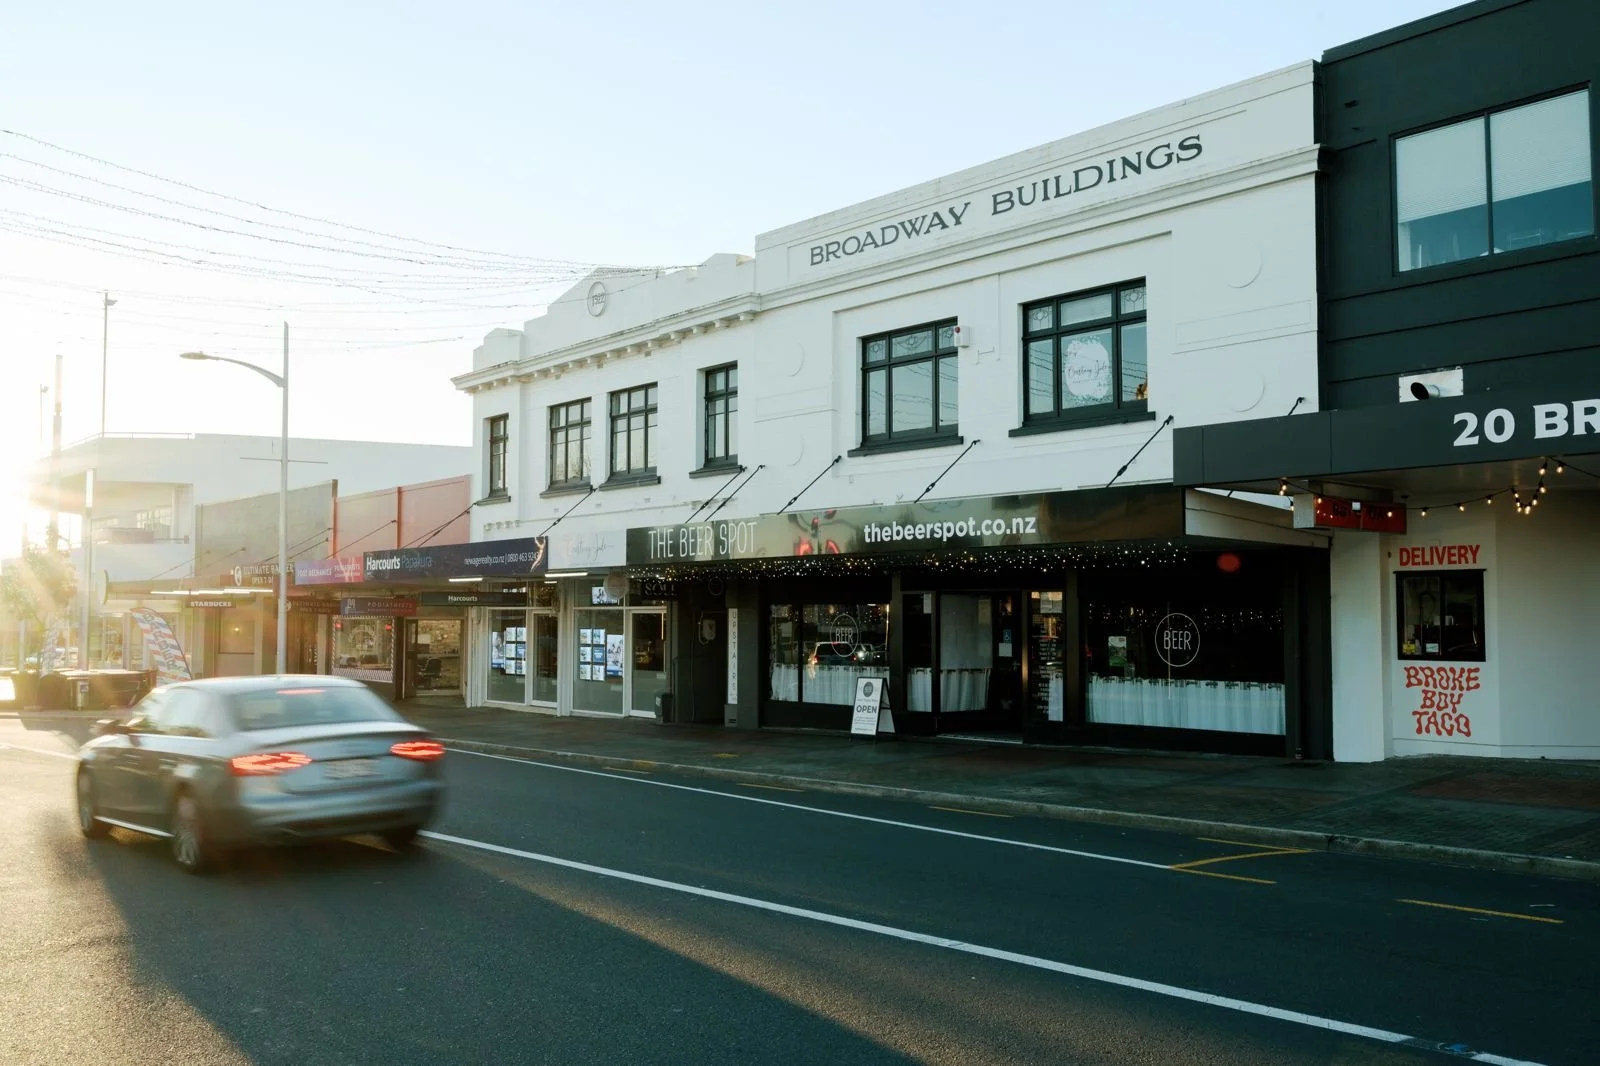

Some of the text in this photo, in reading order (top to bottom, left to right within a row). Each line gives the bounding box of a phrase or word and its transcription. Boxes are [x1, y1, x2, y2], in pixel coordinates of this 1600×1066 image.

[810, 134, 1203, 266] BROADWAY BUILDINGS
[1453, 399, 1600, 447] 20 BR
[648, 527, 674, 559] THE
[679, 525, 714, 558] BEER
[719, 521, 757, 555] SPOT
[863, 516, 1036, 542] thebeerspot.co.nz
[366, 555, 400, 570] Harcourts
[1399, 544, 1480, 566] DELIVERY
[835, 627, 854, 644] BEER
[1163, 630, 1192, 650] BEER
[1404, 666, 1480, 691] BROKE
[856, 704, 878, 714] OPEN
[1420, 689, 1463, 713] BOY
[1412, 711, 1471, 737] TACO
